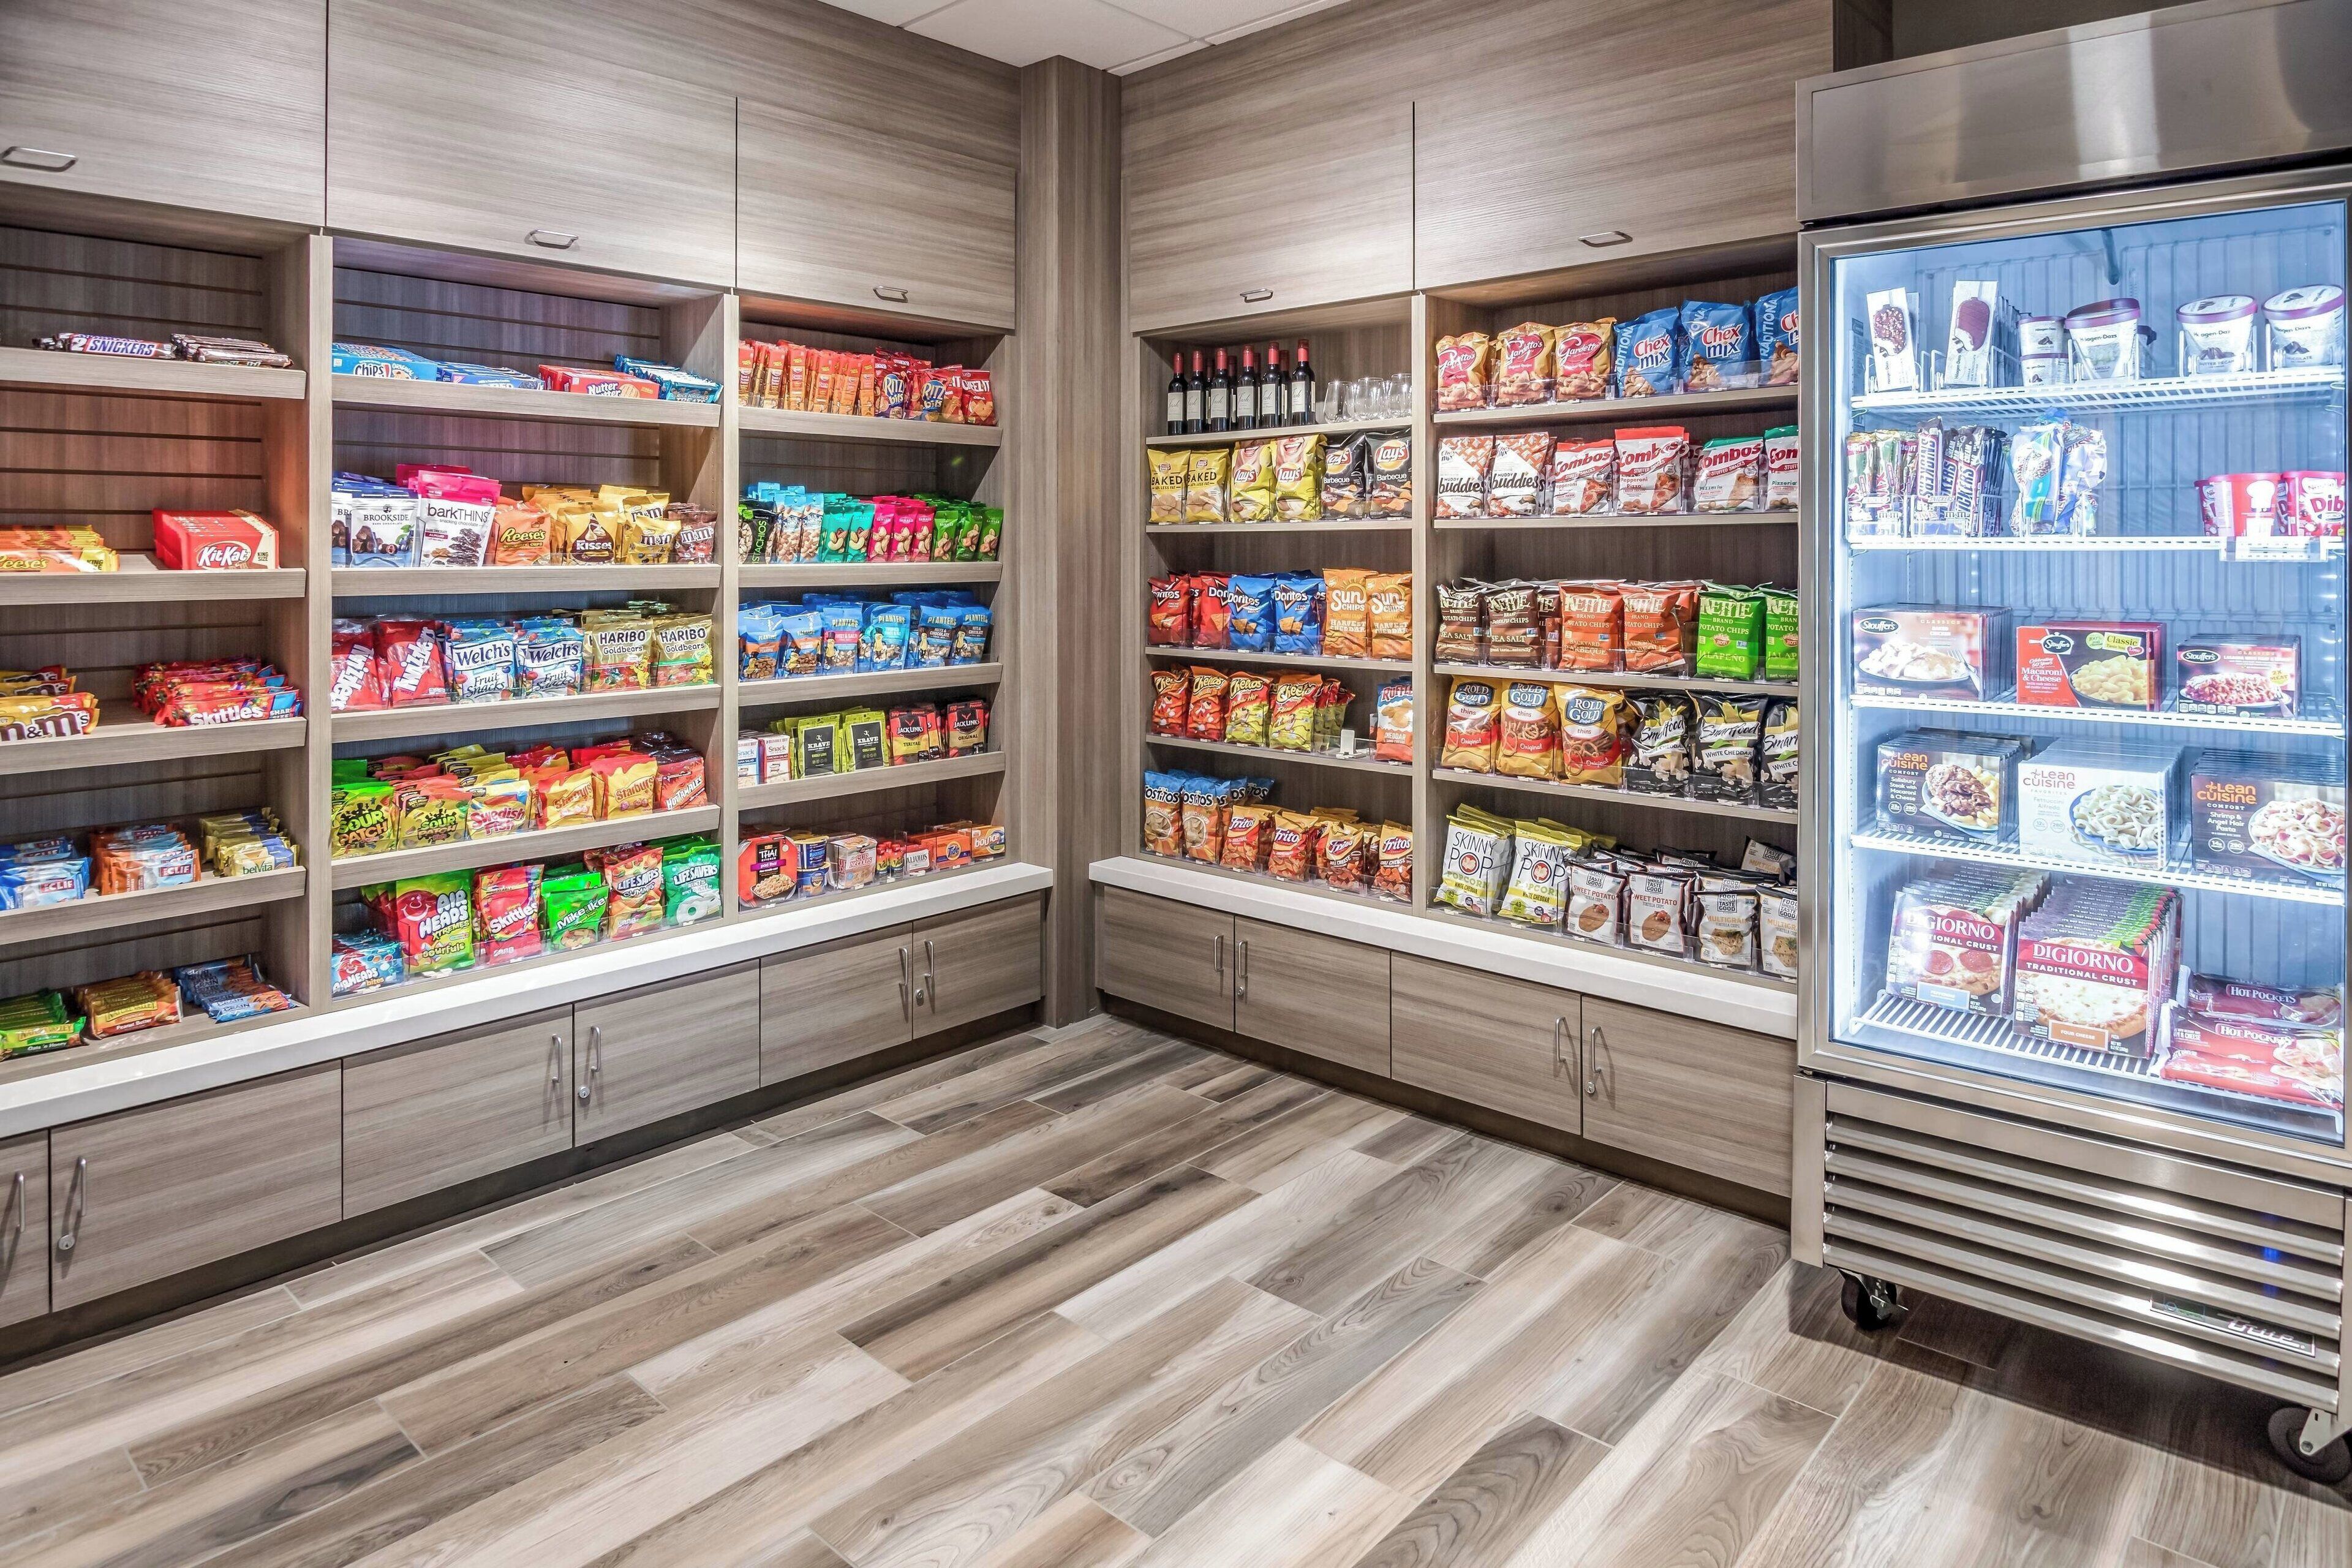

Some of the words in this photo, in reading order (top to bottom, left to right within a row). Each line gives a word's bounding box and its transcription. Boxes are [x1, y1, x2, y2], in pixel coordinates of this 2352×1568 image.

[1703, 323, 1743, 345] Chex
[89, 339, 155, 355] SNICKERS
[1634, 334, 1670, 357] Chex
[1706, 337, 1742, 358] mix
[1640, 348, 1670, 369] mix
[587, 382, 619, 394] Nutter
[884, 377, 903, 396] RITZ
[922, 385, 944, 399] RITZ
[1710, 468, 1728, 477] STUFFED
[1728, 461, 1745, 471] SNACKS
[1152, 476, 1182, 486] BAKED
[1188, 472, 1216, 483] BAKED
[1439, 478, 1486, 494] buddies
[2310, 495, 2344, 513] Dib
[500, 529, 546, 542] Reese's
[752, 521, 766, 563] ISTACHIOS
[1275, 590, 1308, 601] Doritos
[1699, 597, 1754, 618] KETTLE
[878, 615, 905, 624] PLANTERS
[927, 617, 957, 625] PLANTERS
[965, 614, 988, 623] PLANTERS
[1699, 624, 1725, 632] POTATO
[1727, 626, 1749, 635] CHIPS
[1861, 620, 1896, 632] Stouffer's
[600, 630, 646, 644] HARIBO
[660, 628, 706, 643] HARIBO
[1455, 632, 1473, 641] SALT
[2106, 635, 2138, 646] Classic
[603, 645, 643, 655] Goldbears
[665, 643, 705, 653] Goldbears
[2044, 638, 2071, 651] Stouffer's
[455, 643, 510, 665] Welch's
[529, 643, 579, 664] Welch's
[2185, 651, 2216, 661] Stouffer's
[474, 673, 500, 687] Fruit
[544, 670, 568, 682] Fruit
[467, 681, 505, 698] Snacks
[1194, 676, 1224, 693] Cheetos
[1464, 684, 1488, 695] ROLD
[1517, 684, 1543, 694] ROLD
[1456, 692, 1488, 706] GOLD
[1510, 692, 1543, 704] GOLD
[1575, 699, 1602, 710] ROLD
[190, 707, 263, 726] Skittles
[1569, 708, 1599, 721] GOLD
[1701, 723, 1757, 739] Smartfood
[1585, 757, 1610, 766] Original
[1772, 762, 1791, 771] WHITE
[340, 810, 384, 832] SOUR
[420, 815, 456, 827] SOUR
[470, 807, 525, 826] Swedish
[2210, 812, 2235, 820] Shrimp
[1231, 817, 1255, 829] Fritos
[339, 822, 388, 845] PATCH
[975, 834, 1000, 848] bounce
[1384, 837, 1411, 851] Fritos
[759, 849, 777, 858] THAI
[948, 845, 960, 857] Tide
[243, 862, 273, 875] belVita
[848, 858, 872, 867] NOODLES
[1448, 847, 1494, 878] POP
[166, 865, 191, 876] CLIF
[1518, 858, 1566, 887] POP
[44, 880, 74, 893] CLIF
[1574, 884, 1591, 894] SWEET
[1593, 891, 1616, 900] POTATO
[437, 889, 468, 914] AIR
[1653, 897, 1677, 905] POTATO
[419, 905, 469, 939] HEADS
[489, 902, 538, 935] Skittles
[1966, 940, 1999, 951] CRUST
[2033, 944, 2133, 974] DIGIORNO
[2026, 962, 2098, 979] TRADITIONAL
[2101, 974, 2138, 986] CRUST
[366, 977, 385, 986] bites
[2231, 986, 2251, 997] HOT
[2252, 990, 2296, 1004] POCKETS
[2220, 1025, 2242, 1036] HOT
